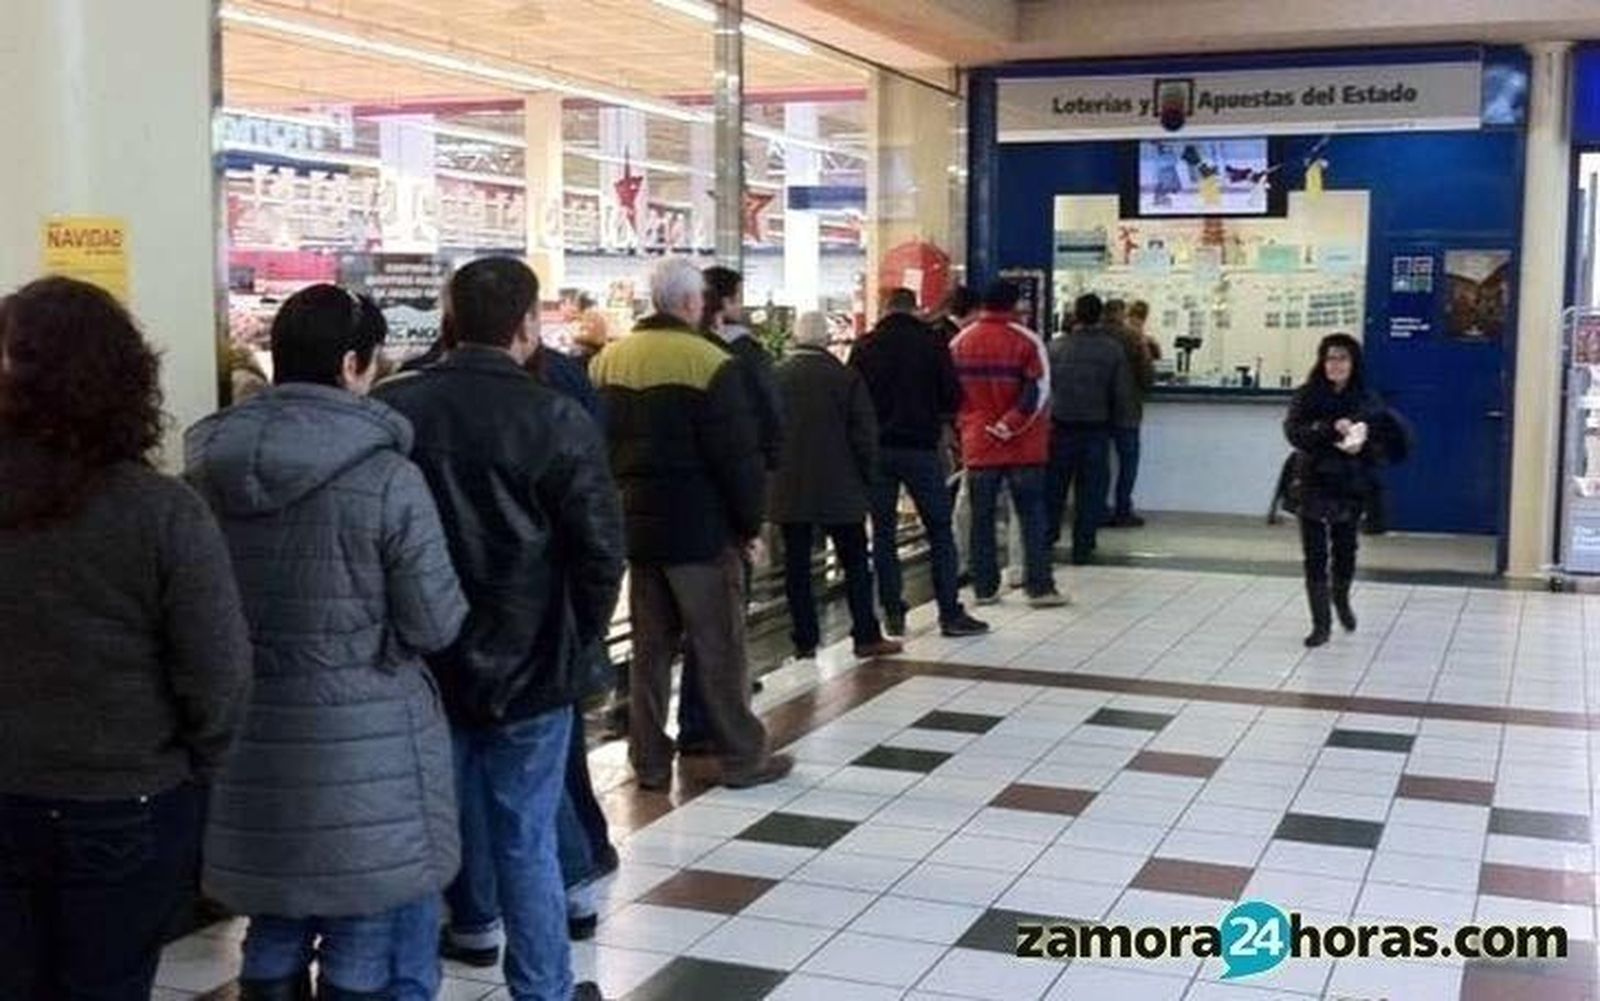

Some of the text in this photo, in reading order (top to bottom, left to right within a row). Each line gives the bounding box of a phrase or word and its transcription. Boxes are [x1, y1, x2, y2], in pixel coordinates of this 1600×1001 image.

[1139, 97, 1150, 117] y
[1197, 90, 1295, 112] Apuestas
[1302, 87, 1335, 107] del
[1341, 82, 1418, 105] Estado
[48, 229, 121, 248] NAVIDAD
